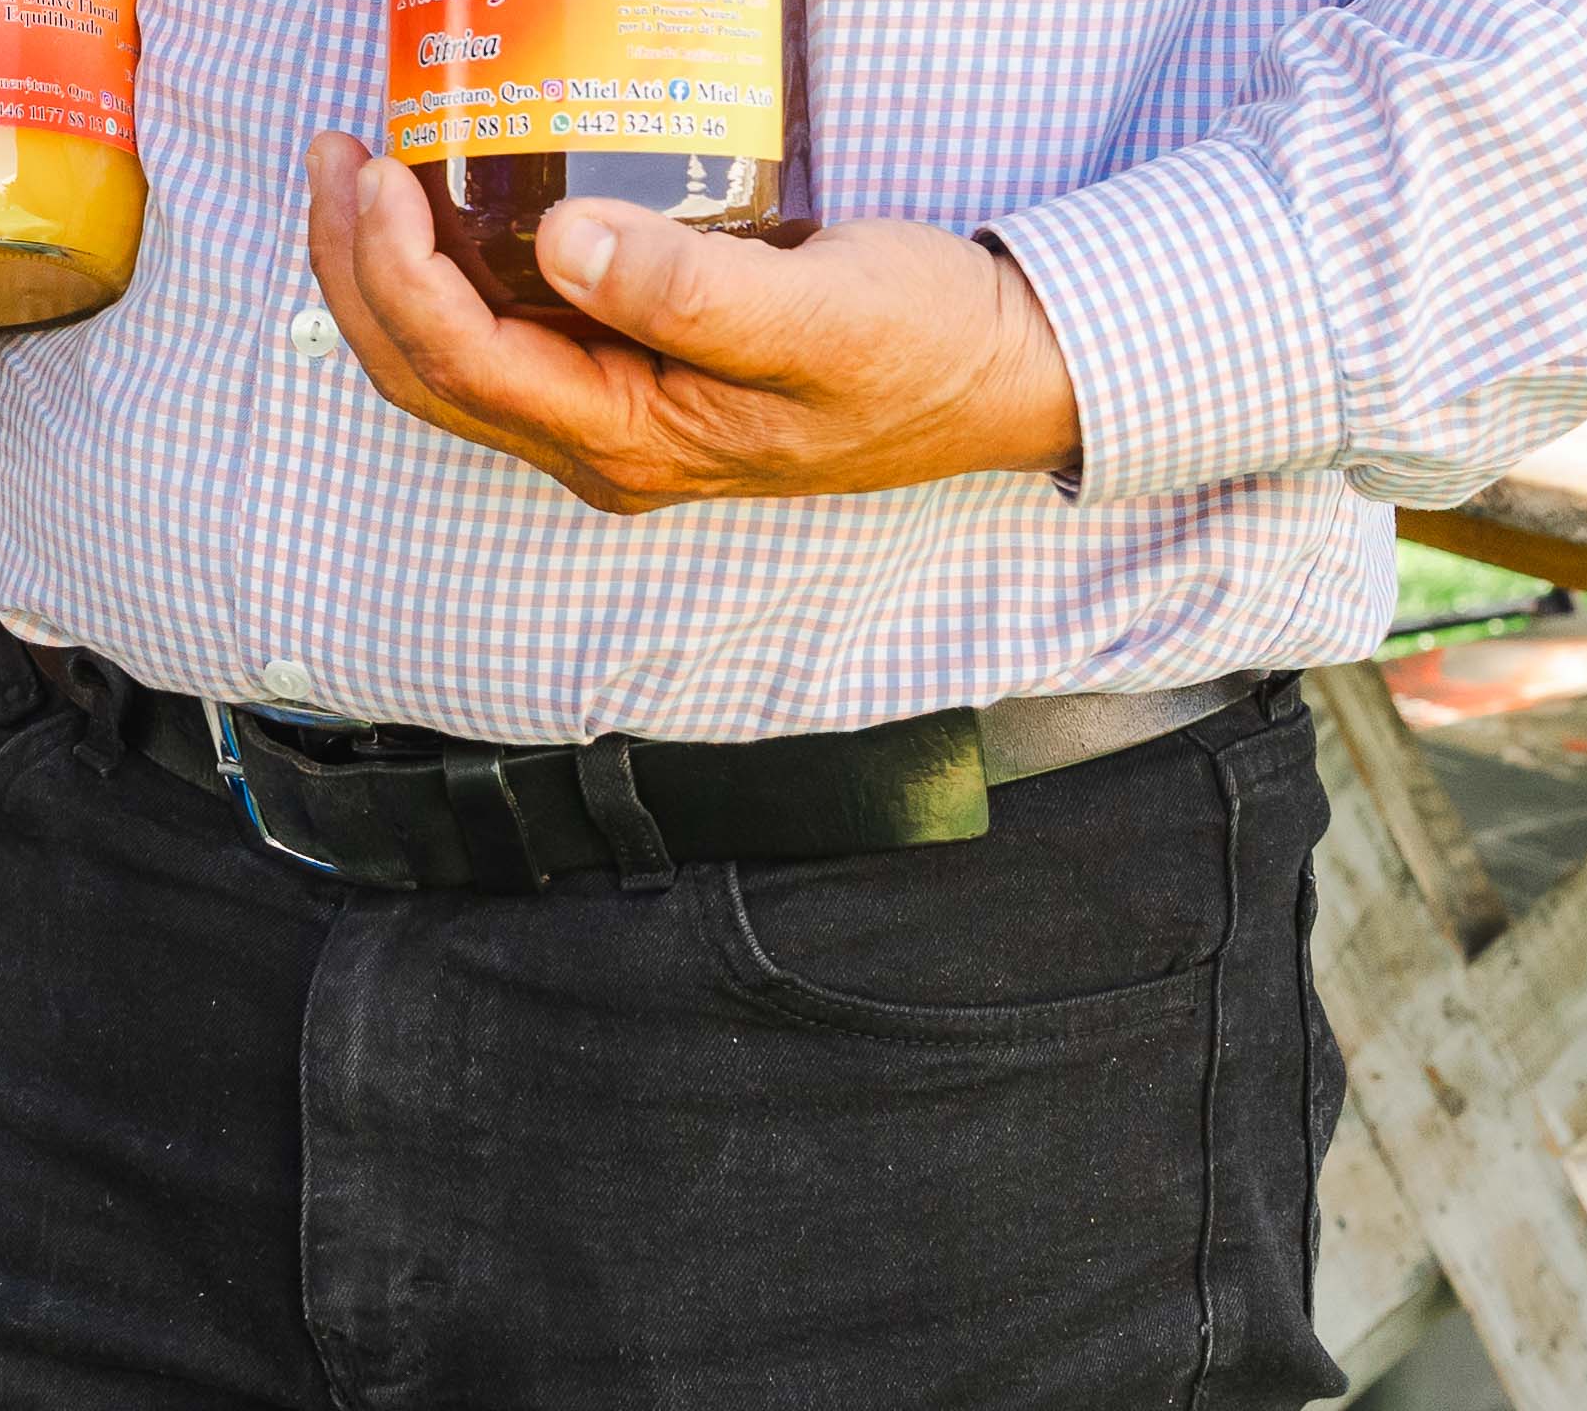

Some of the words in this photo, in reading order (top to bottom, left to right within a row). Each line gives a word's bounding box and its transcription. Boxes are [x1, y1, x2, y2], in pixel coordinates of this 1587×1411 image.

[5, 5, 104, 37] Equilibrado
[418, 30, 501, 67] Cítrica
[68, 82, 96, 104] Qro.
[422, 85, 496, 111] Querétaro,
[500, 82, 540, 104] Qro.
[570, 80, 618, 100] Miel
[624, 80, 663, 101] Ató
[697, 83, 739, 104] Miel
[744, 84, 774, 106] Ató
[576, 113, 616, 134] 442
[624, 113, 664, 134] 324
[670, 115, 695, 135] 33
[702, 119, 725, 138] 46
